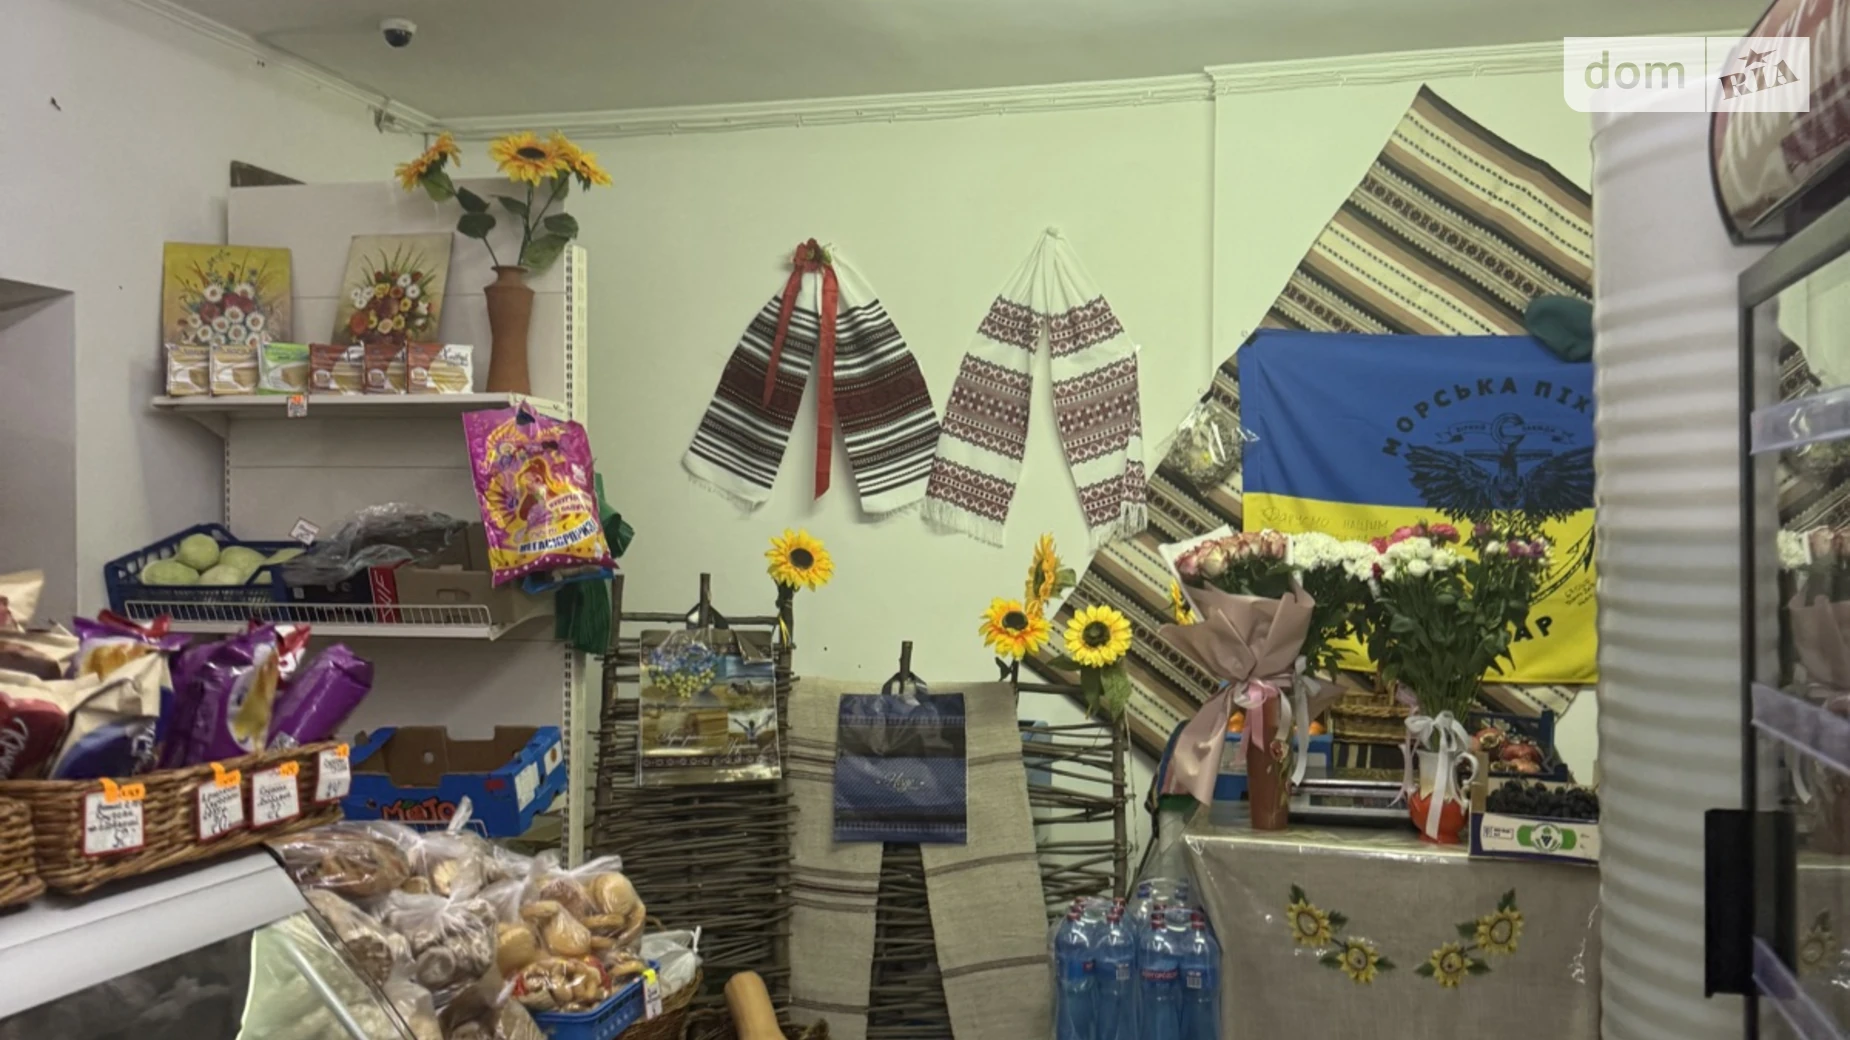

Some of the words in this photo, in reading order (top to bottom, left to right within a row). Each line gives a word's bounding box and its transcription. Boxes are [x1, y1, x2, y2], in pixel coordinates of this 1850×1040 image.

[1382, 377, 1517, 456] МОРСЬКА
[1534, 380, 1593, 414] ПІХ
[1513, 615, 1553, 643] АР
